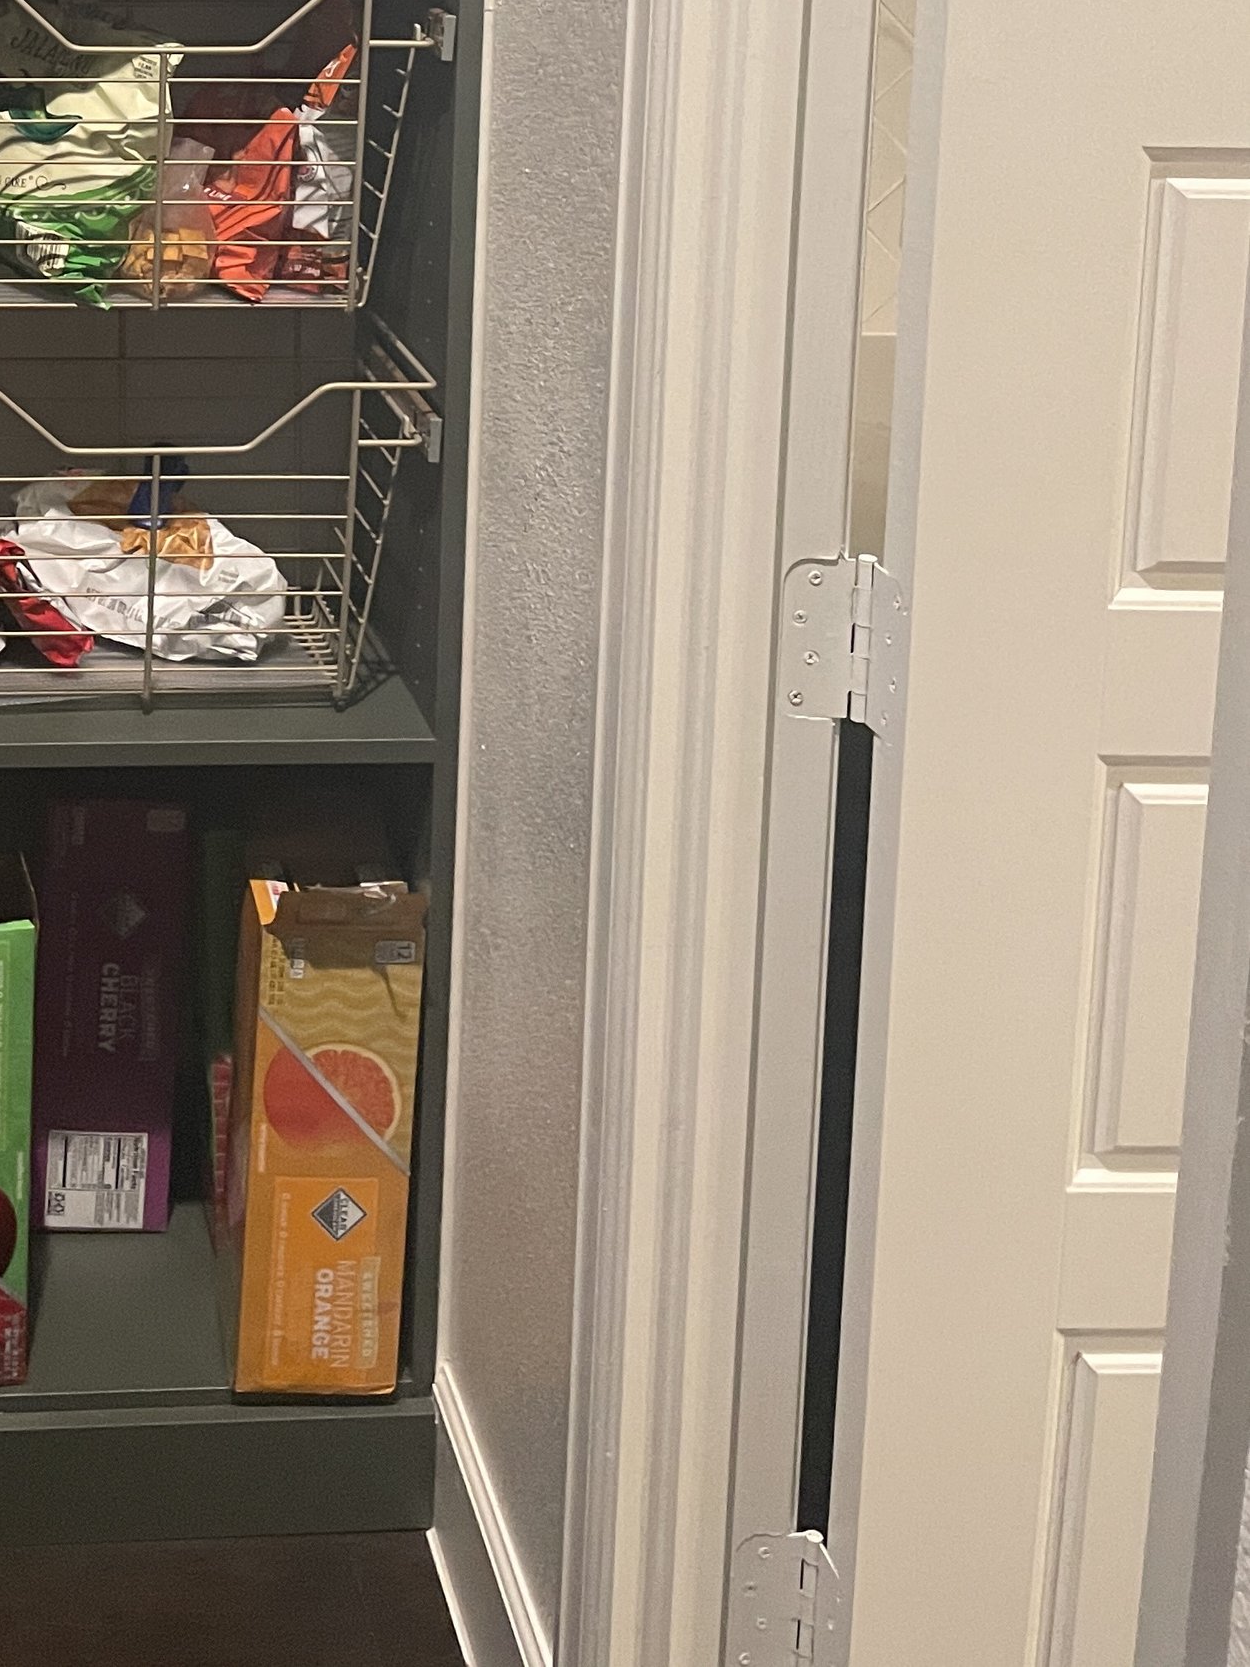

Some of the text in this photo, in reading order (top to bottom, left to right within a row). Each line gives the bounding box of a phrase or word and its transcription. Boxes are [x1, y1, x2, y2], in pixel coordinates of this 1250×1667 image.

[398, 942, 413, 959] 12
[99, 962, 120, 1053] CHERRY
[339, 1197, 349, 1231] CLEAR
[311, 1267, 334, 1360] ORANGE
[329, 1259, 357, 1369] MANDARIN
